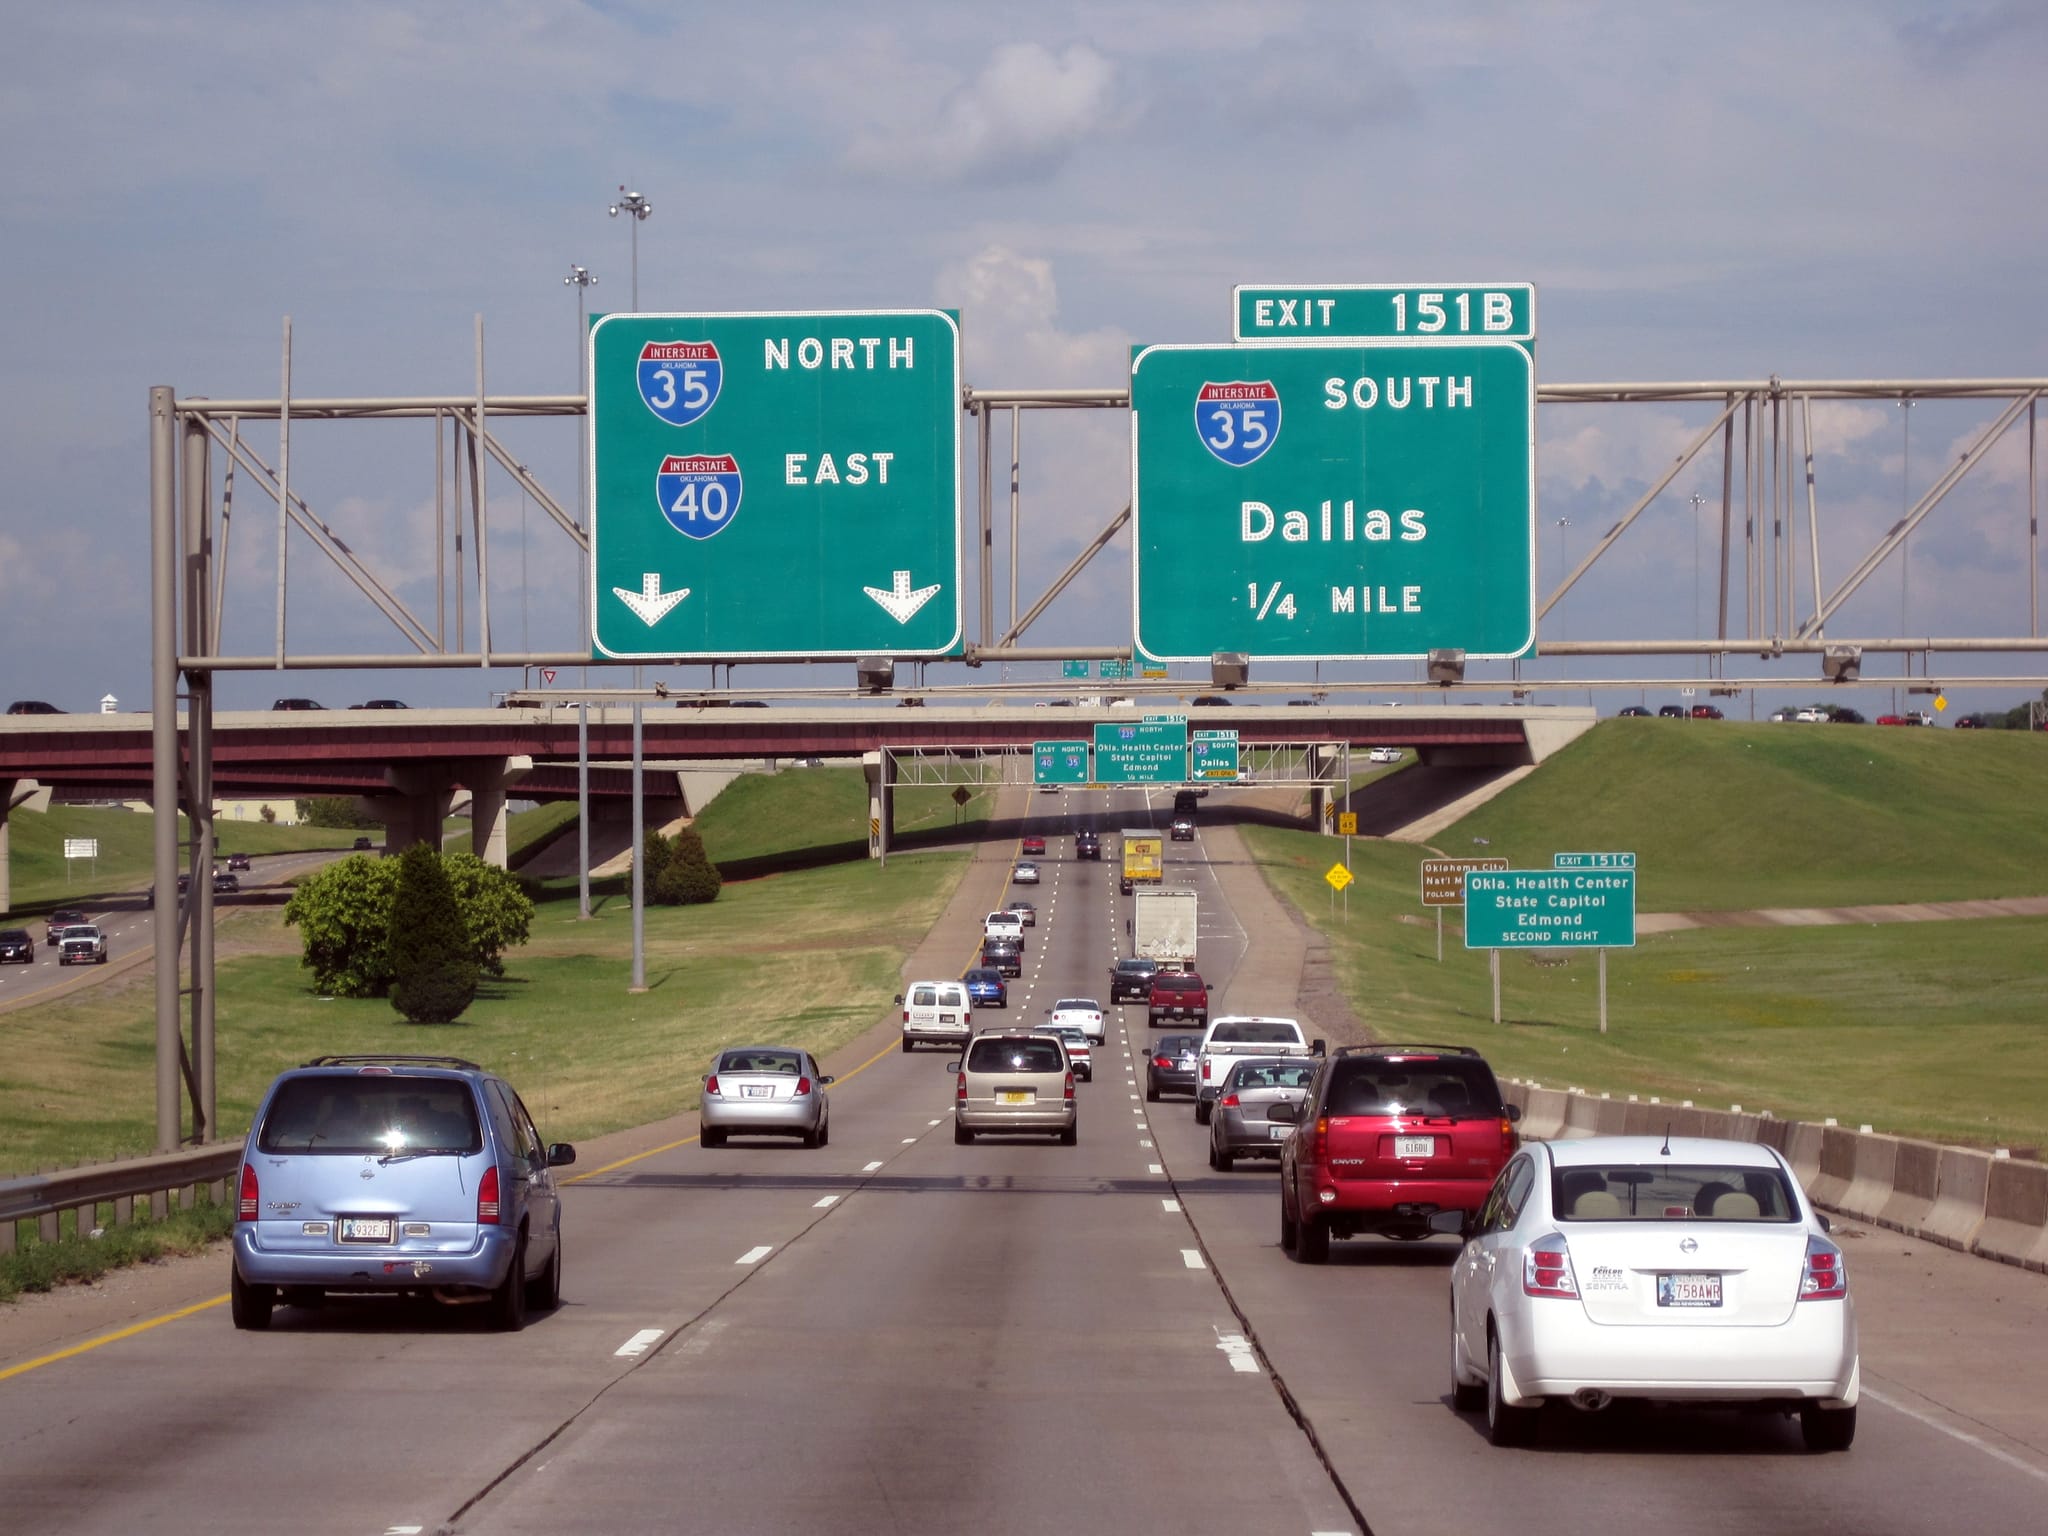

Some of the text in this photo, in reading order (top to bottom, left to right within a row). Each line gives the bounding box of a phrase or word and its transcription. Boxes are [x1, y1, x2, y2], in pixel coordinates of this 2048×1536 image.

[1255, 293, 1514, 332] EXIT 151B
[650, 347, 709, 359] INTERSTATE
[764, 337, 914, 369] NORTH
[651, 370, 709, 409] 35
[1208, 386, 1267, 399] INTERSTATE
[1324, 376, 1472, 410] SOUTH
[1209, 410, 1268, 450] 35
[670, 460, 728, 472] INTERSTATE
[785, 452, 894, 485] EAST
[671, 482, 728, 521] 40
[1241, 499, 1428, 542] Dallas
[1247, 581, 1422, 621] 1/4 MILE
[1139, 754, 1172, 762] Capitol
[1200, 759, 1230, 767] Dallas
[1123, 763, 1159, 771] Edmond
[1342, 821, 1354, 829] 45
[1425, 863, 1504, 872] Oklahoma City
[1559, 855, 1630, 867] EXIT 151C
[1426, 877, 1450, 885] Nat'l
[1472, 878, 1510, 890] Okla.
[1516, 877, 1569, 890] Health
[1575, 876, 1629, 889] Center
[1495, 895, 1606, 909] State Capitol
[1518, 913, 1582, 926] Edmond
[1502, 931, 1598, 942] SECOND RIGHT
[1676, 1284, 1721, 1299] 758AWR
